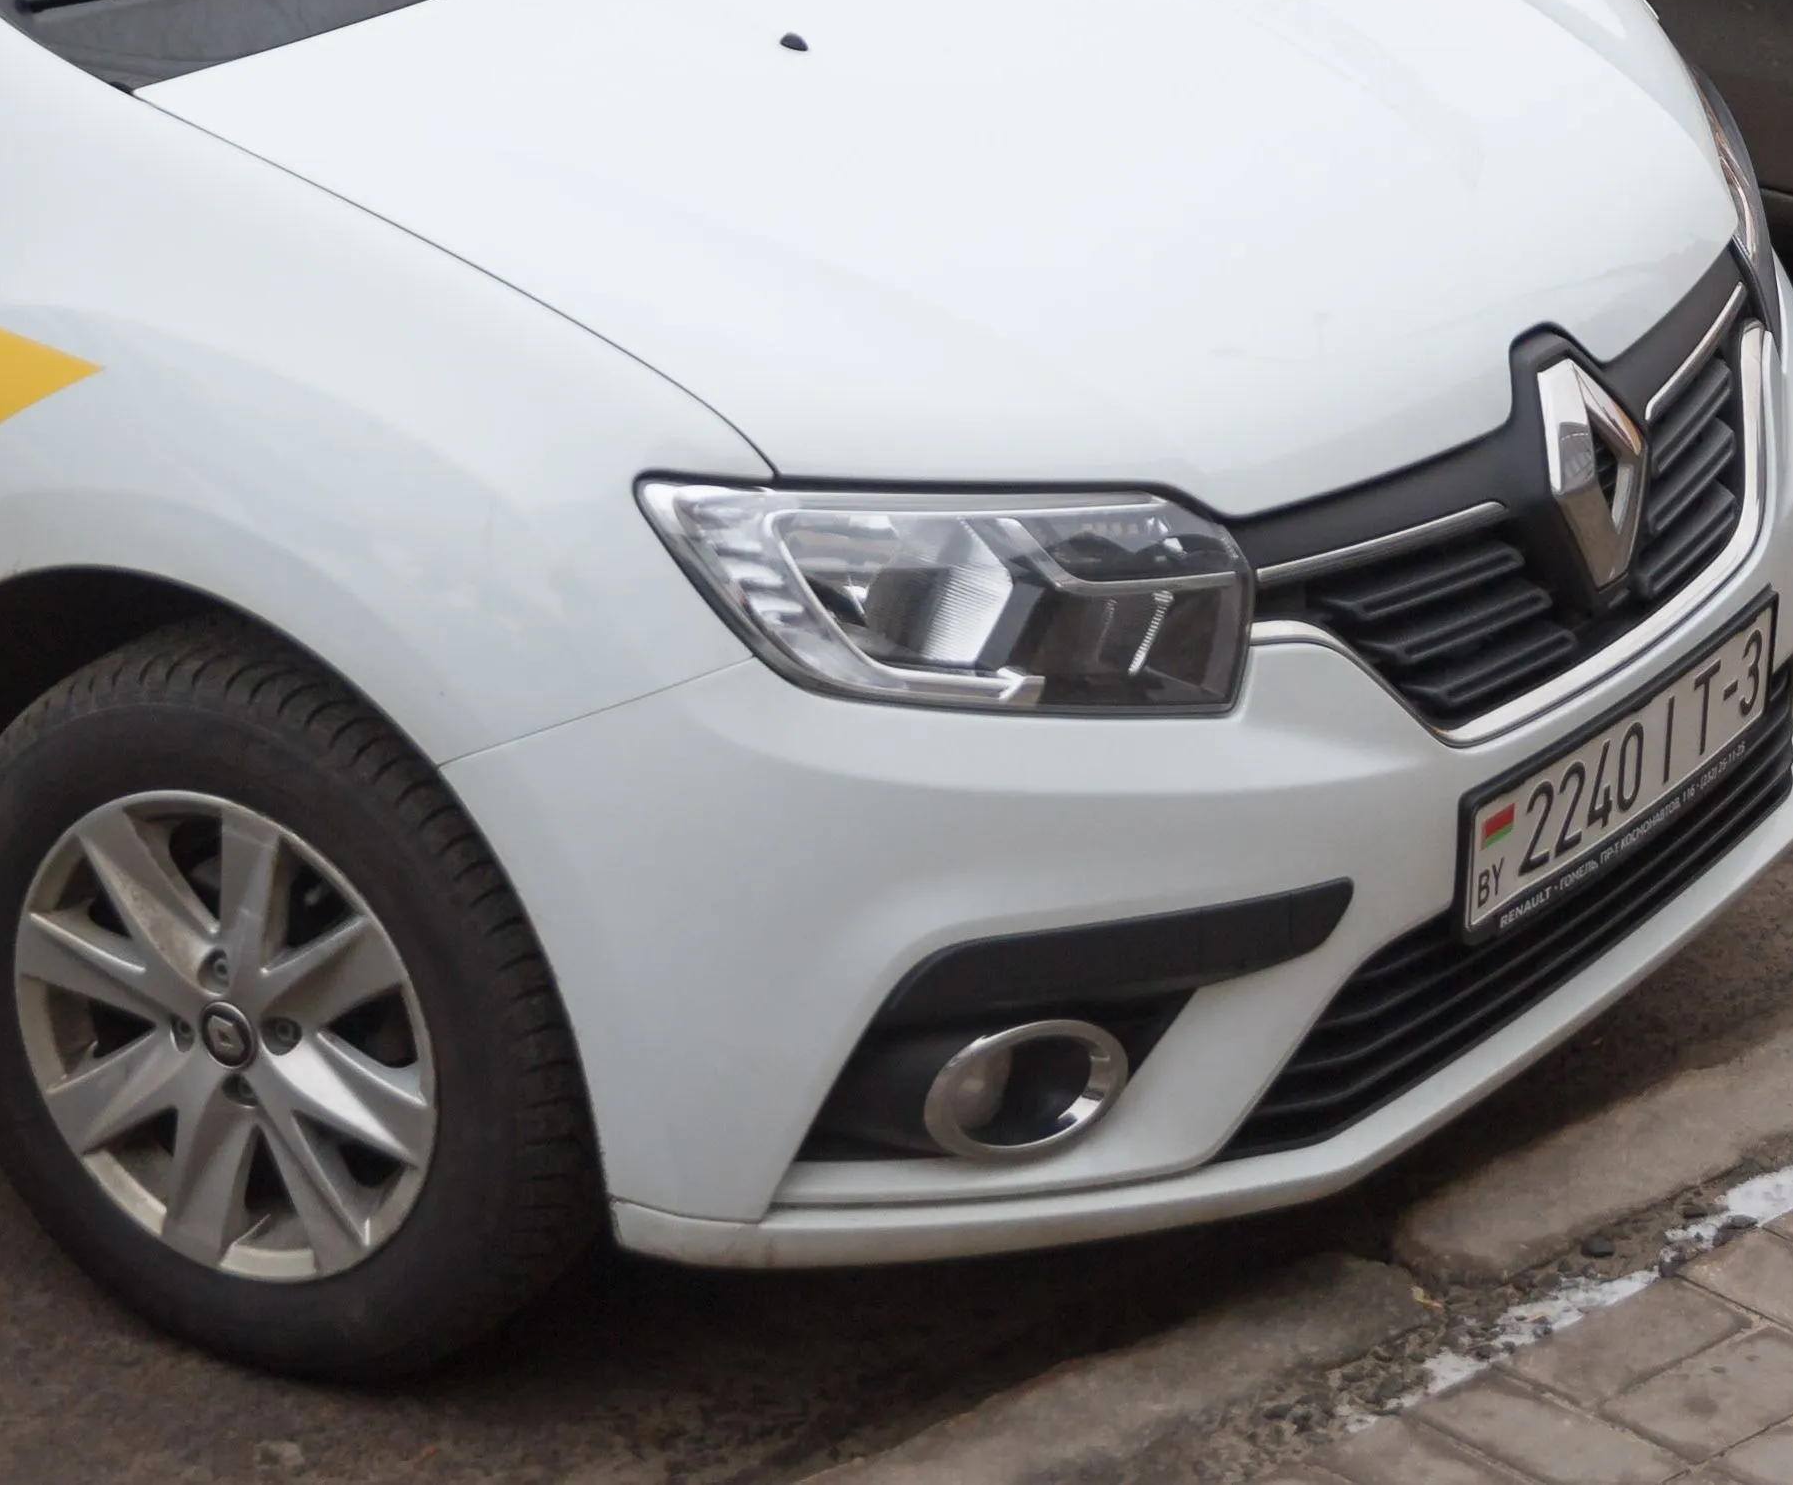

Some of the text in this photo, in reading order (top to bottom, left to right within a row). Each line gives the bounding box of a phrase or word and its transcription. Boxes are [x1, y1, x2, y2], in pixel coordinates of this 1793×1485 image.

[1518, 721, 1645, 877] 2240
[1477, 858, 1505, 907] BY
[1499, 888, 1553, 929] RENAULT
